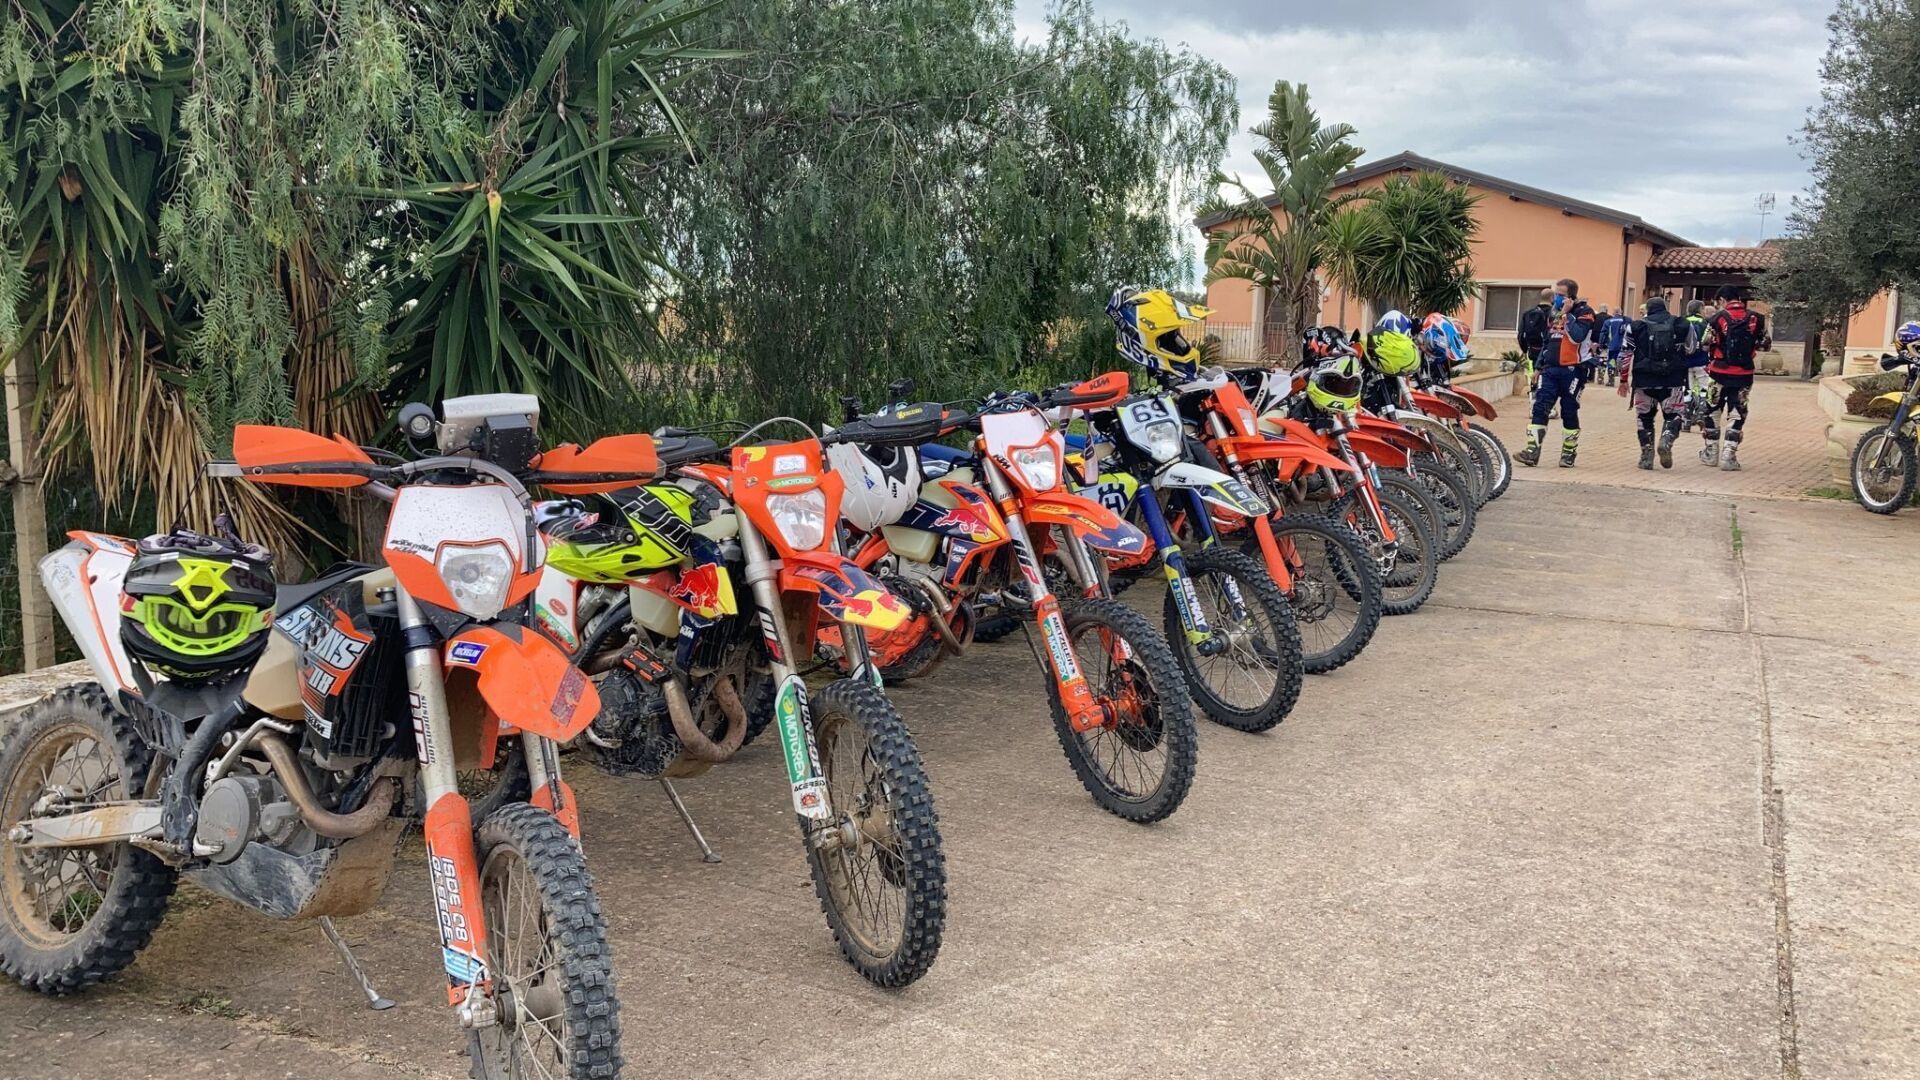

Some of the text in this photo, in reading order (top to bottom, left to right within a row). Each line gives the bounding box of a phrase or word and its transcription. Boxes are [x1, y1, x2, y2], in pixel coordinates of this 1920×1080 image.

[1089, 377, 1110, 390] KTM
[1132, 399, 1169, 423] 69
[993, 454, 1011, 469] KTM
[1117, 537, 1139, 547] KTM
[680, 624, 694, 639] KTM
[1052, 617, 1074, 666] METZELER
[421, 695, 436, 764] suspension
[784, 714, 806, 780] MOTOREX
[797, 687, 823, 777] DUNLOP
[441, 856, 468, 943] ISDE 08
